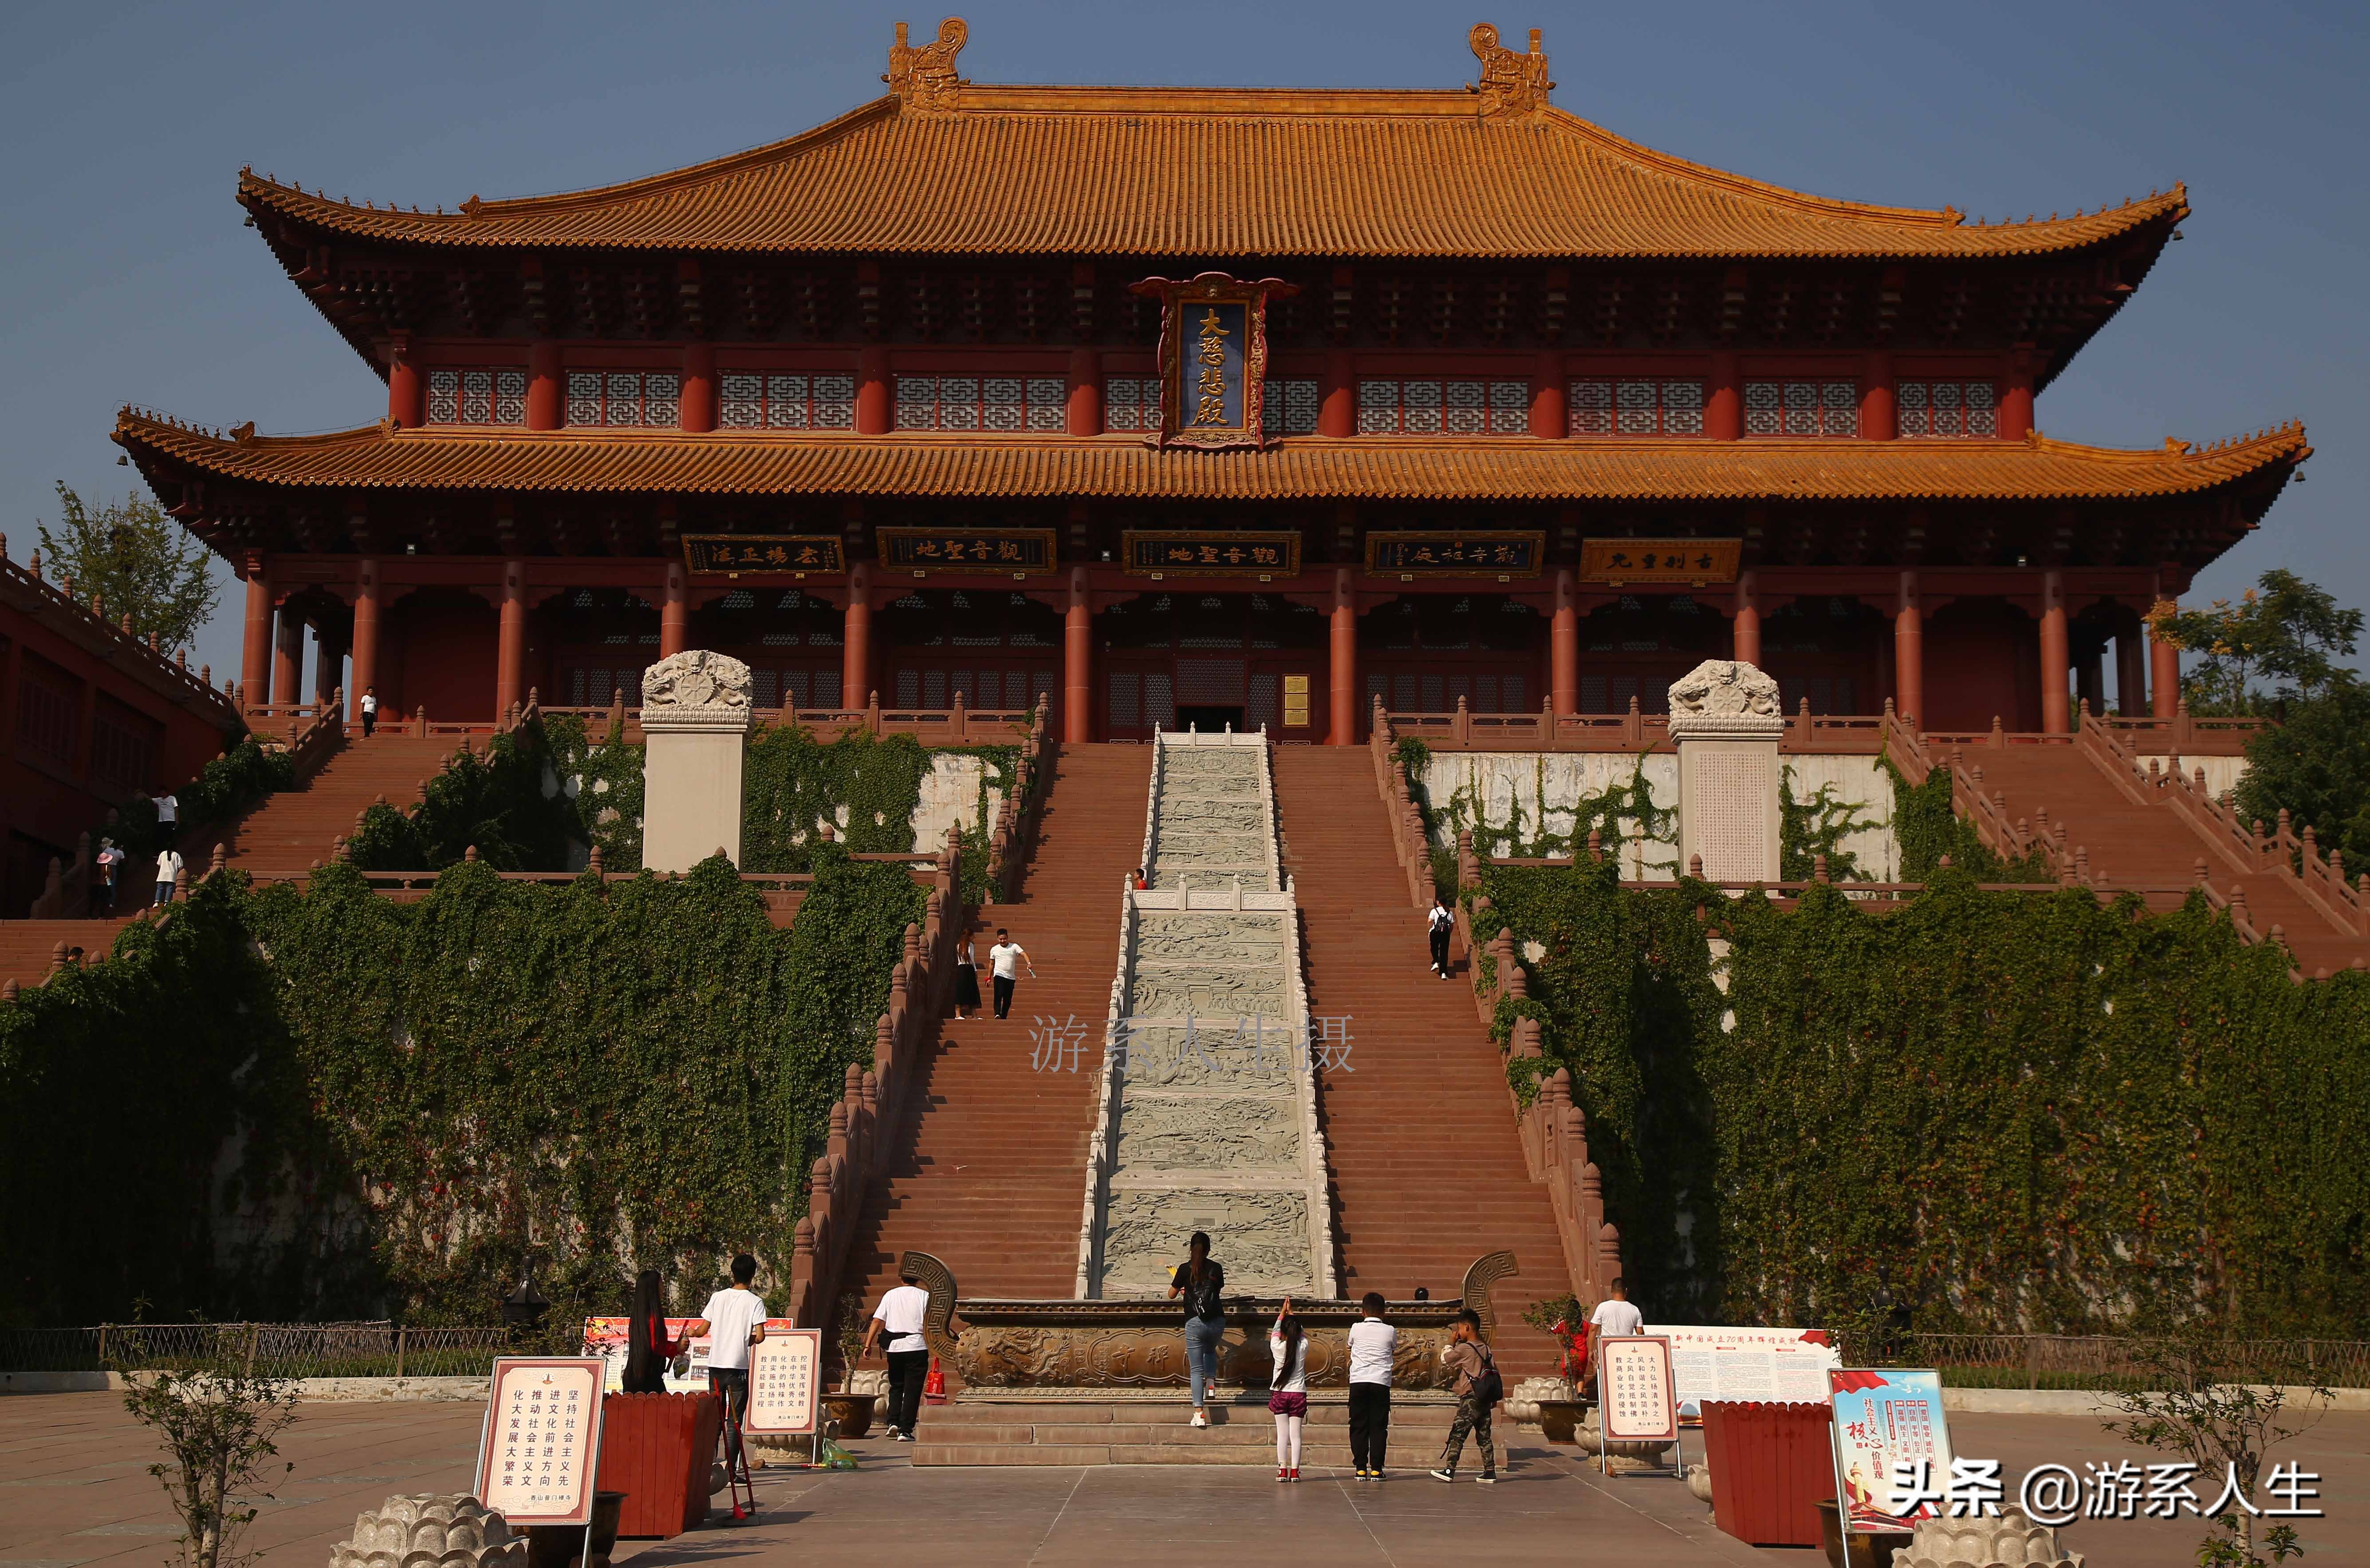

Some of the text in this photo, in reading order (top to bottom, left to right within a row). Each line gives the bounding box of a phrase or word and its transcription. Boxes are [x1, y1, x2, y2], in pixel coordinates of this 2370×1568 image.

[1192, 308, 1230, 426] 大慈悲殿
[1675, 1334, 1798, 1345] 新中国成立70周年辉煌成就
[757, 1356, 767, 1407] 教正能量工程
[768, 1356, 777, 1407] 用实施弘扬宗
[778, 1356, 787, 1407] 化中的特殊作
[788, 1356, 798, 1407] 在中华优秀文
[798, 1356, 807, 1407] 挖掘发挥佛教
[1615, 1356, 1626, 1417] 教商业化的侵蚀
[1626, 1356, 1638, 1417] 之风自觉抵制佛
[1638, 1356, 1648, 1417] 风和谐之风简朴
[1649, 1356, 1660, 1417] 大力弘扬清净之
[503, 1390, 524, 1486] 化大发展大繁荣
[521, 1390, 542, 1486] 推动社会主义文
[540, 1390, 560, 1486] 进文化前进方向
[558, 1390, 579, 1486] 坚持社会主义先
[1864, 1398, 1877, 1435] 社会主义
[1871, 1451, 1884, 1480] 价值观
[1909, 1410, 1917, 1422] 自由
[1912, 1425, 1919, 1437] 平等
[1902, 1441, 1909, 1453] 文明
[1914, 1441, 1921, 1453] 公正
[1925, 1441, 1933, 1453] 诚信
